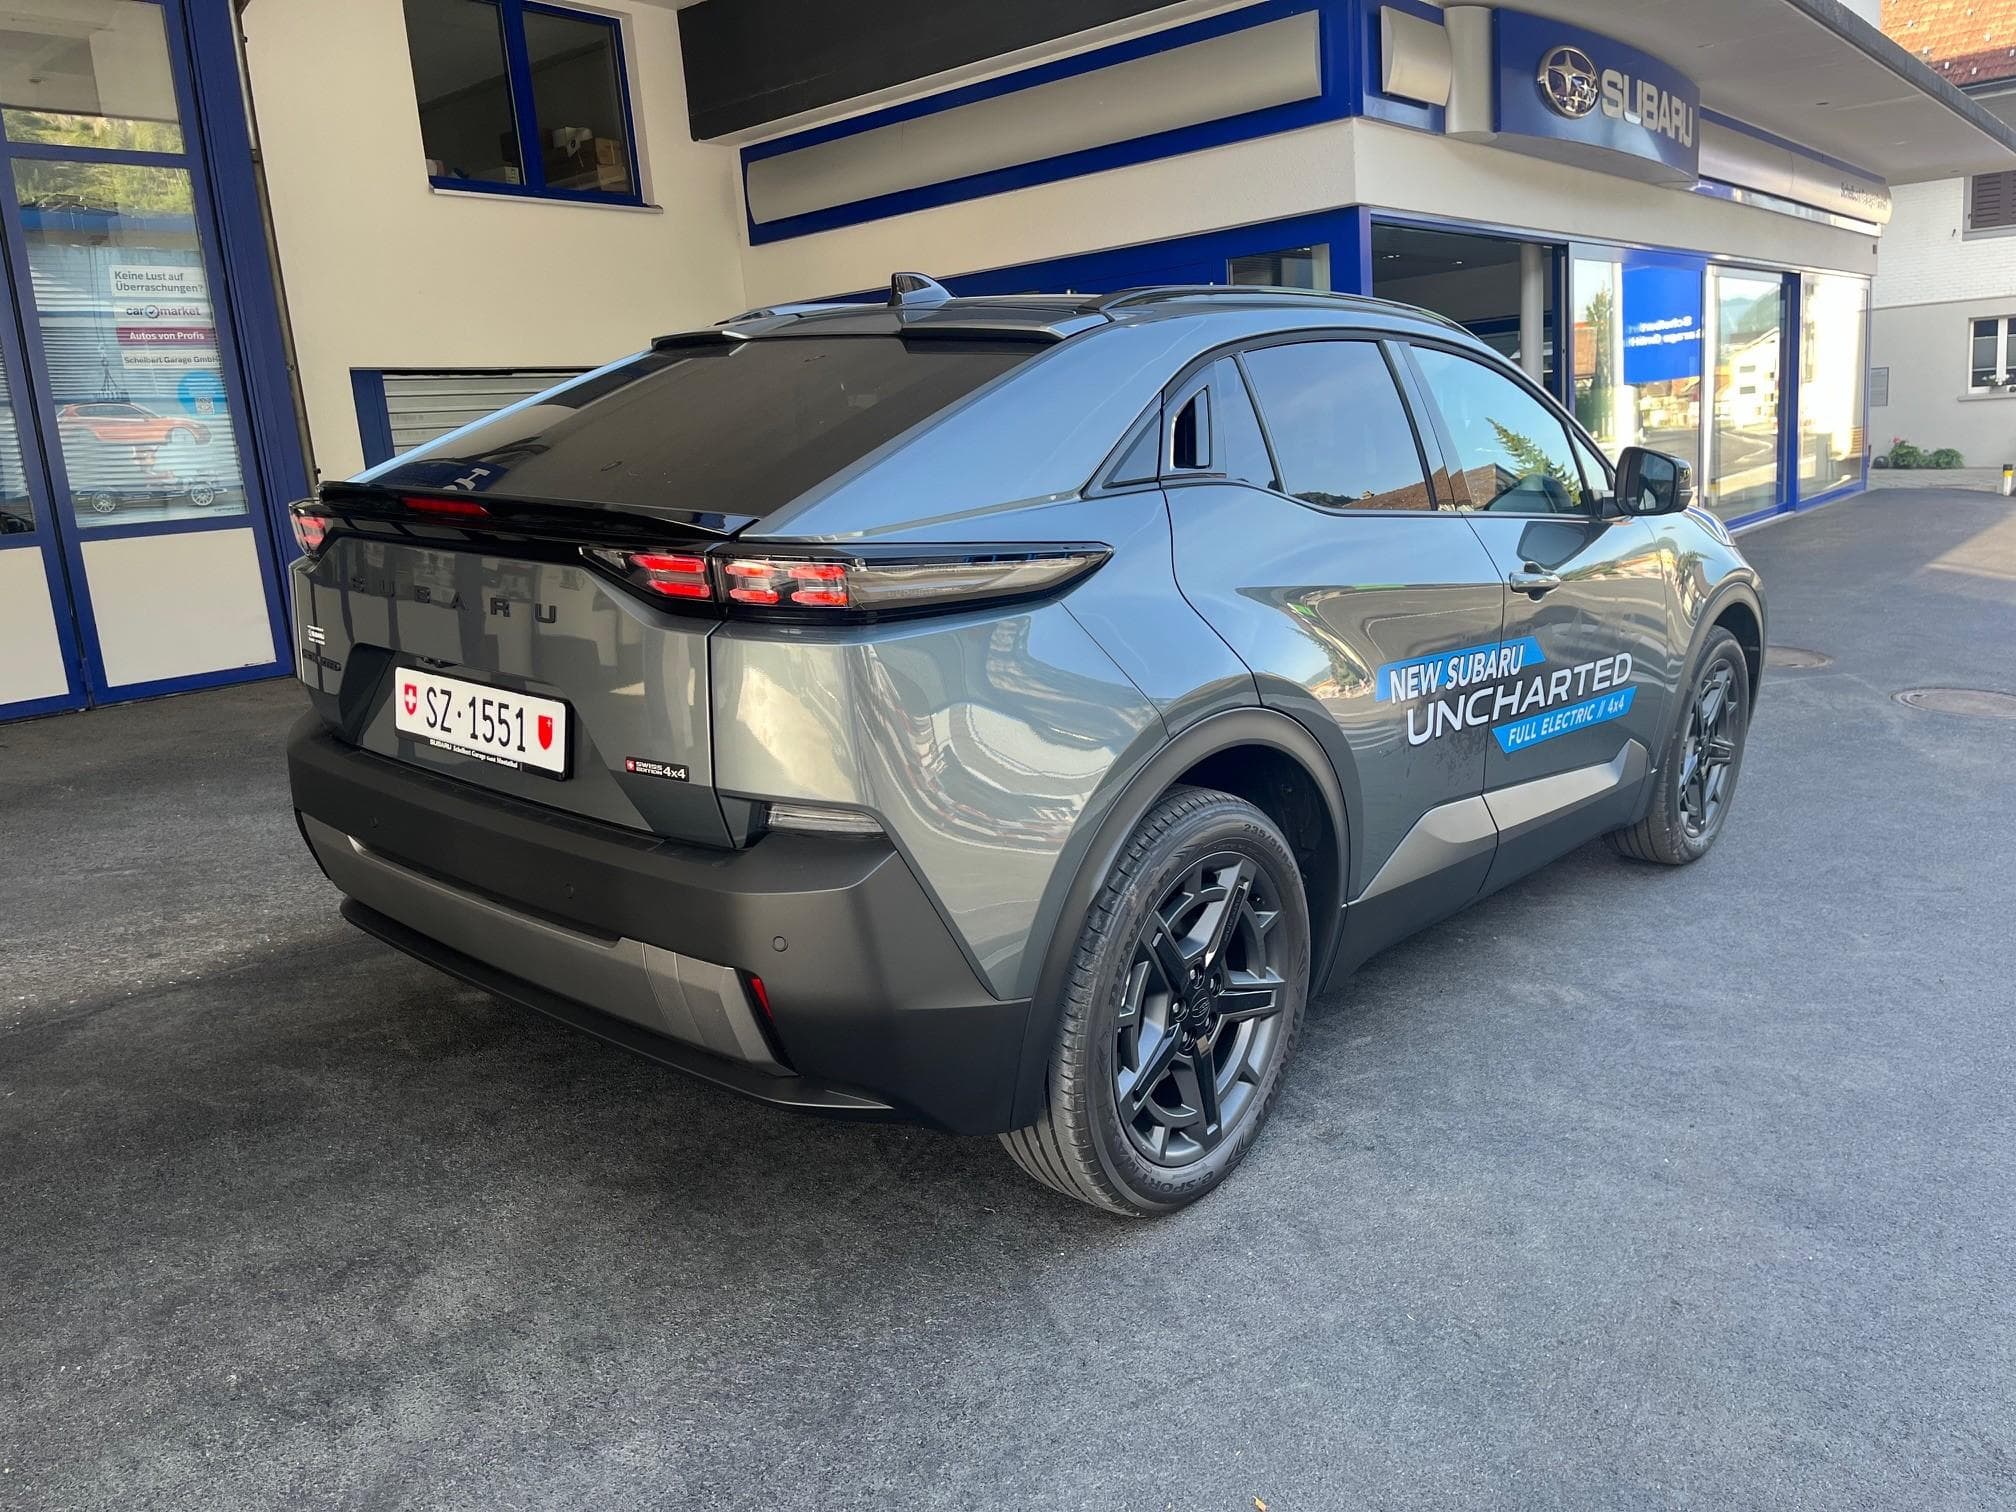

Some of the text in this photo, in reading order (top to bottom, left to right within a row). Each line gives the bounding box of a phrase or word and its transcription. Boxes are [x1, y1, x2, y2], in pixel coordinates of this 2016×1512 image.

[1601, 69, 1693, 148] SUBARU
[114, 271, 184, 281] Keine Lust auf
[115, 281, 203, 293] Überraschungen?
[126, 306, 201, 316] car market
[129, 332, 157, 340] Autos
[177, 332, 205, 340] Profis
[164, 357, 192, 365] Garage
[351, 576, 557, 624] SUBARU
[1390, 644, 1525, 704] NEW SUBARU
[1406, 652, 1633, 747] UNCHARTED
[1508, 722, 1537, 748] FULL
[1540, 703, 1595, 735] ELECTRIC
[1607, 694, 1625, 715] 4x4
[636, 761, 686, 779] SWISS 4x4
[636, 767, 663, 775] EDITION
